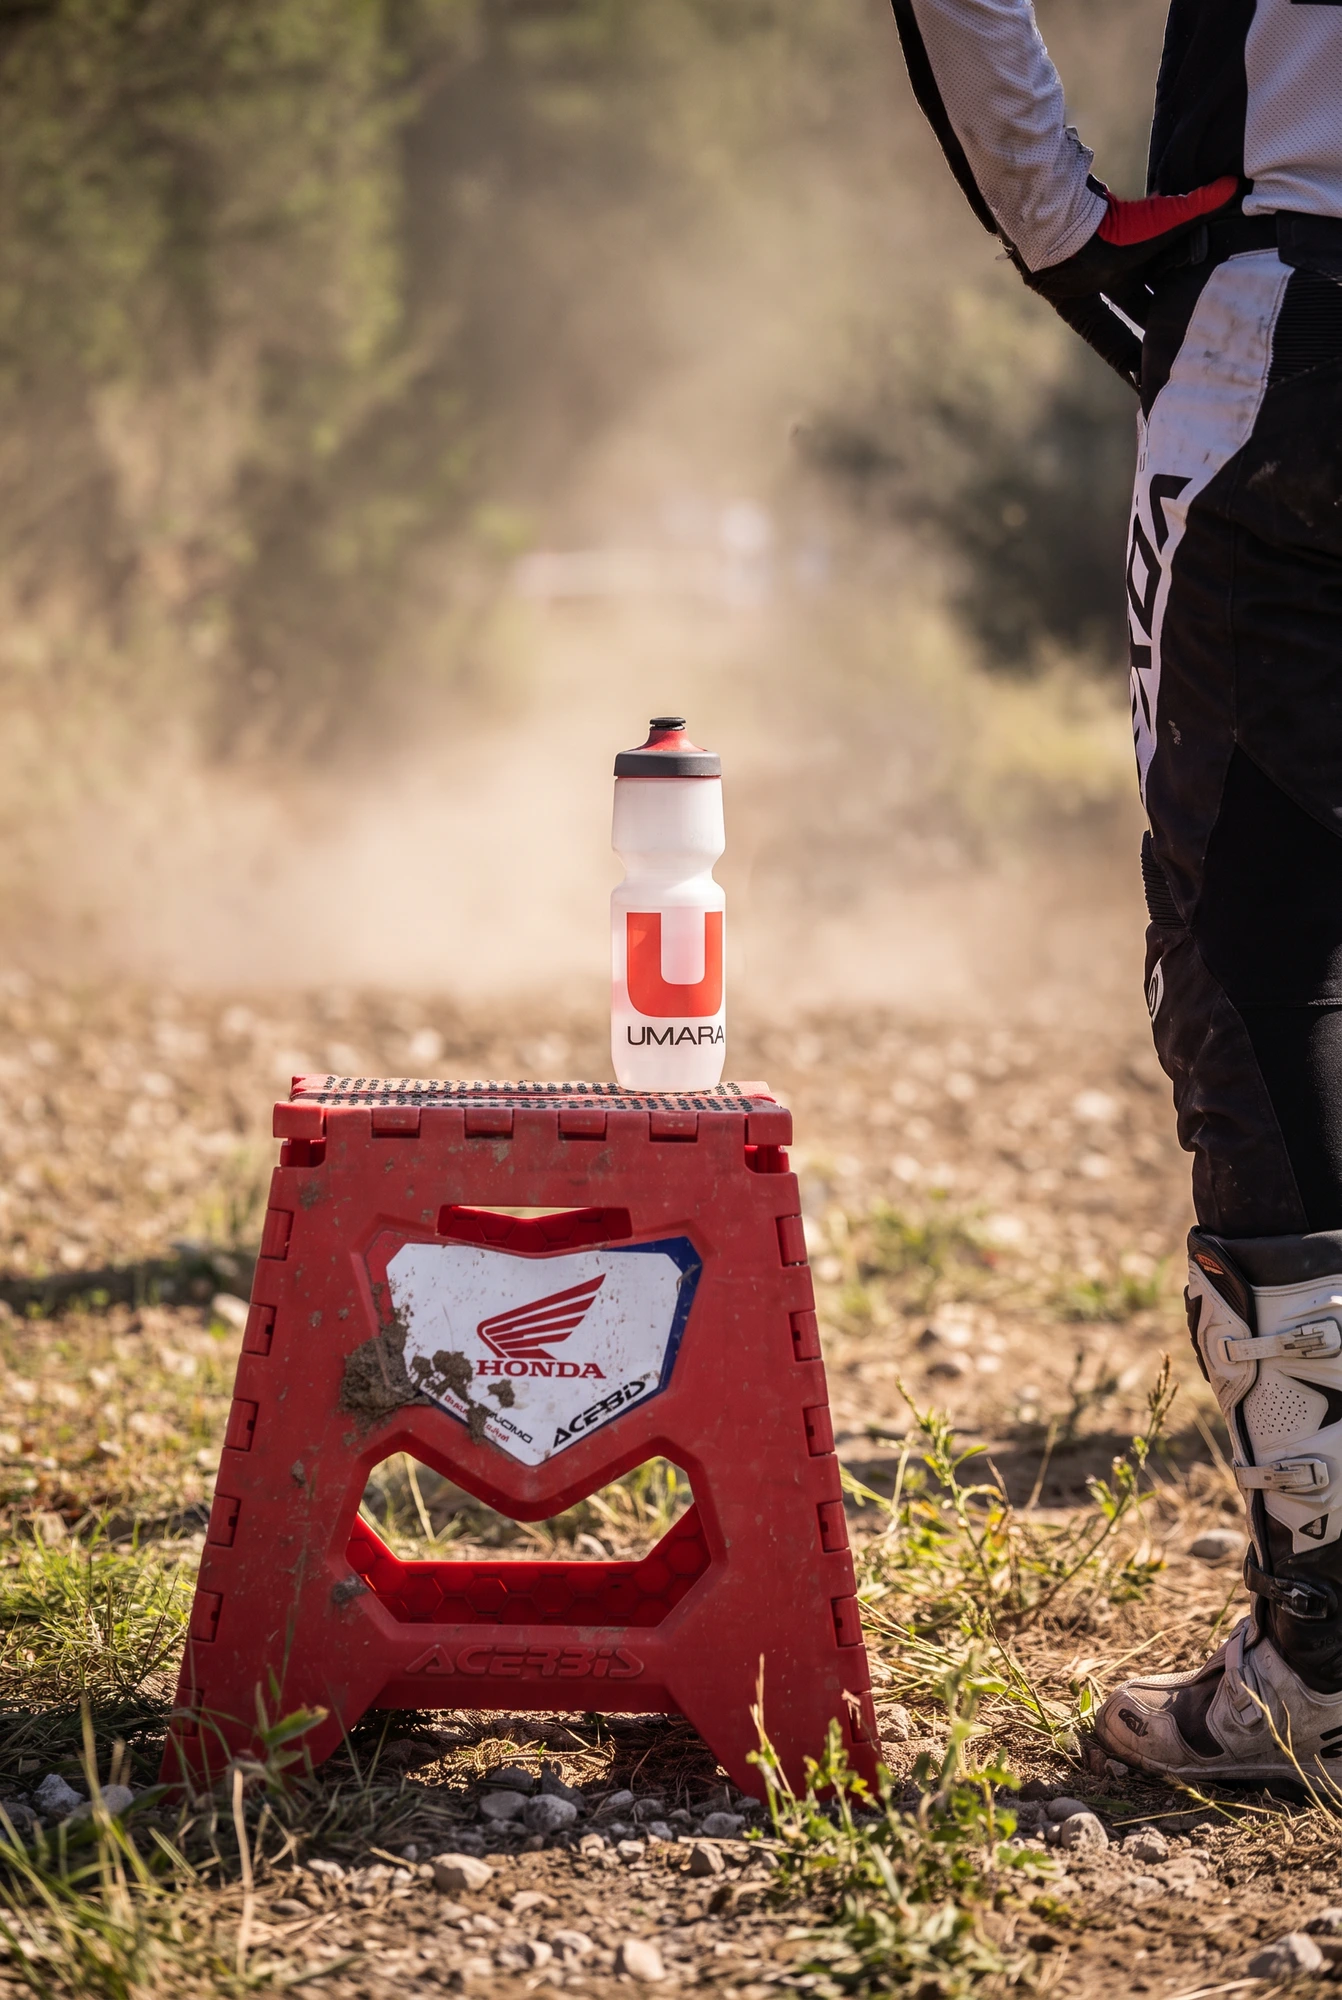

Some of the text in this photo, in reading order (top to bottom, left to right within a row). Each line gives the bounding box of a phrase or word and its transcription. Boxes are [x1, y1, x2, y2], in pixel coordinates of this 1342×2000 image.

[626, 911, 723, 1018] U
[627, 1025, 724, 1046] UMARA
[475, 1359, 607, 1379] HONDA
[405, 1643, 645, 1678] ACERBIS
